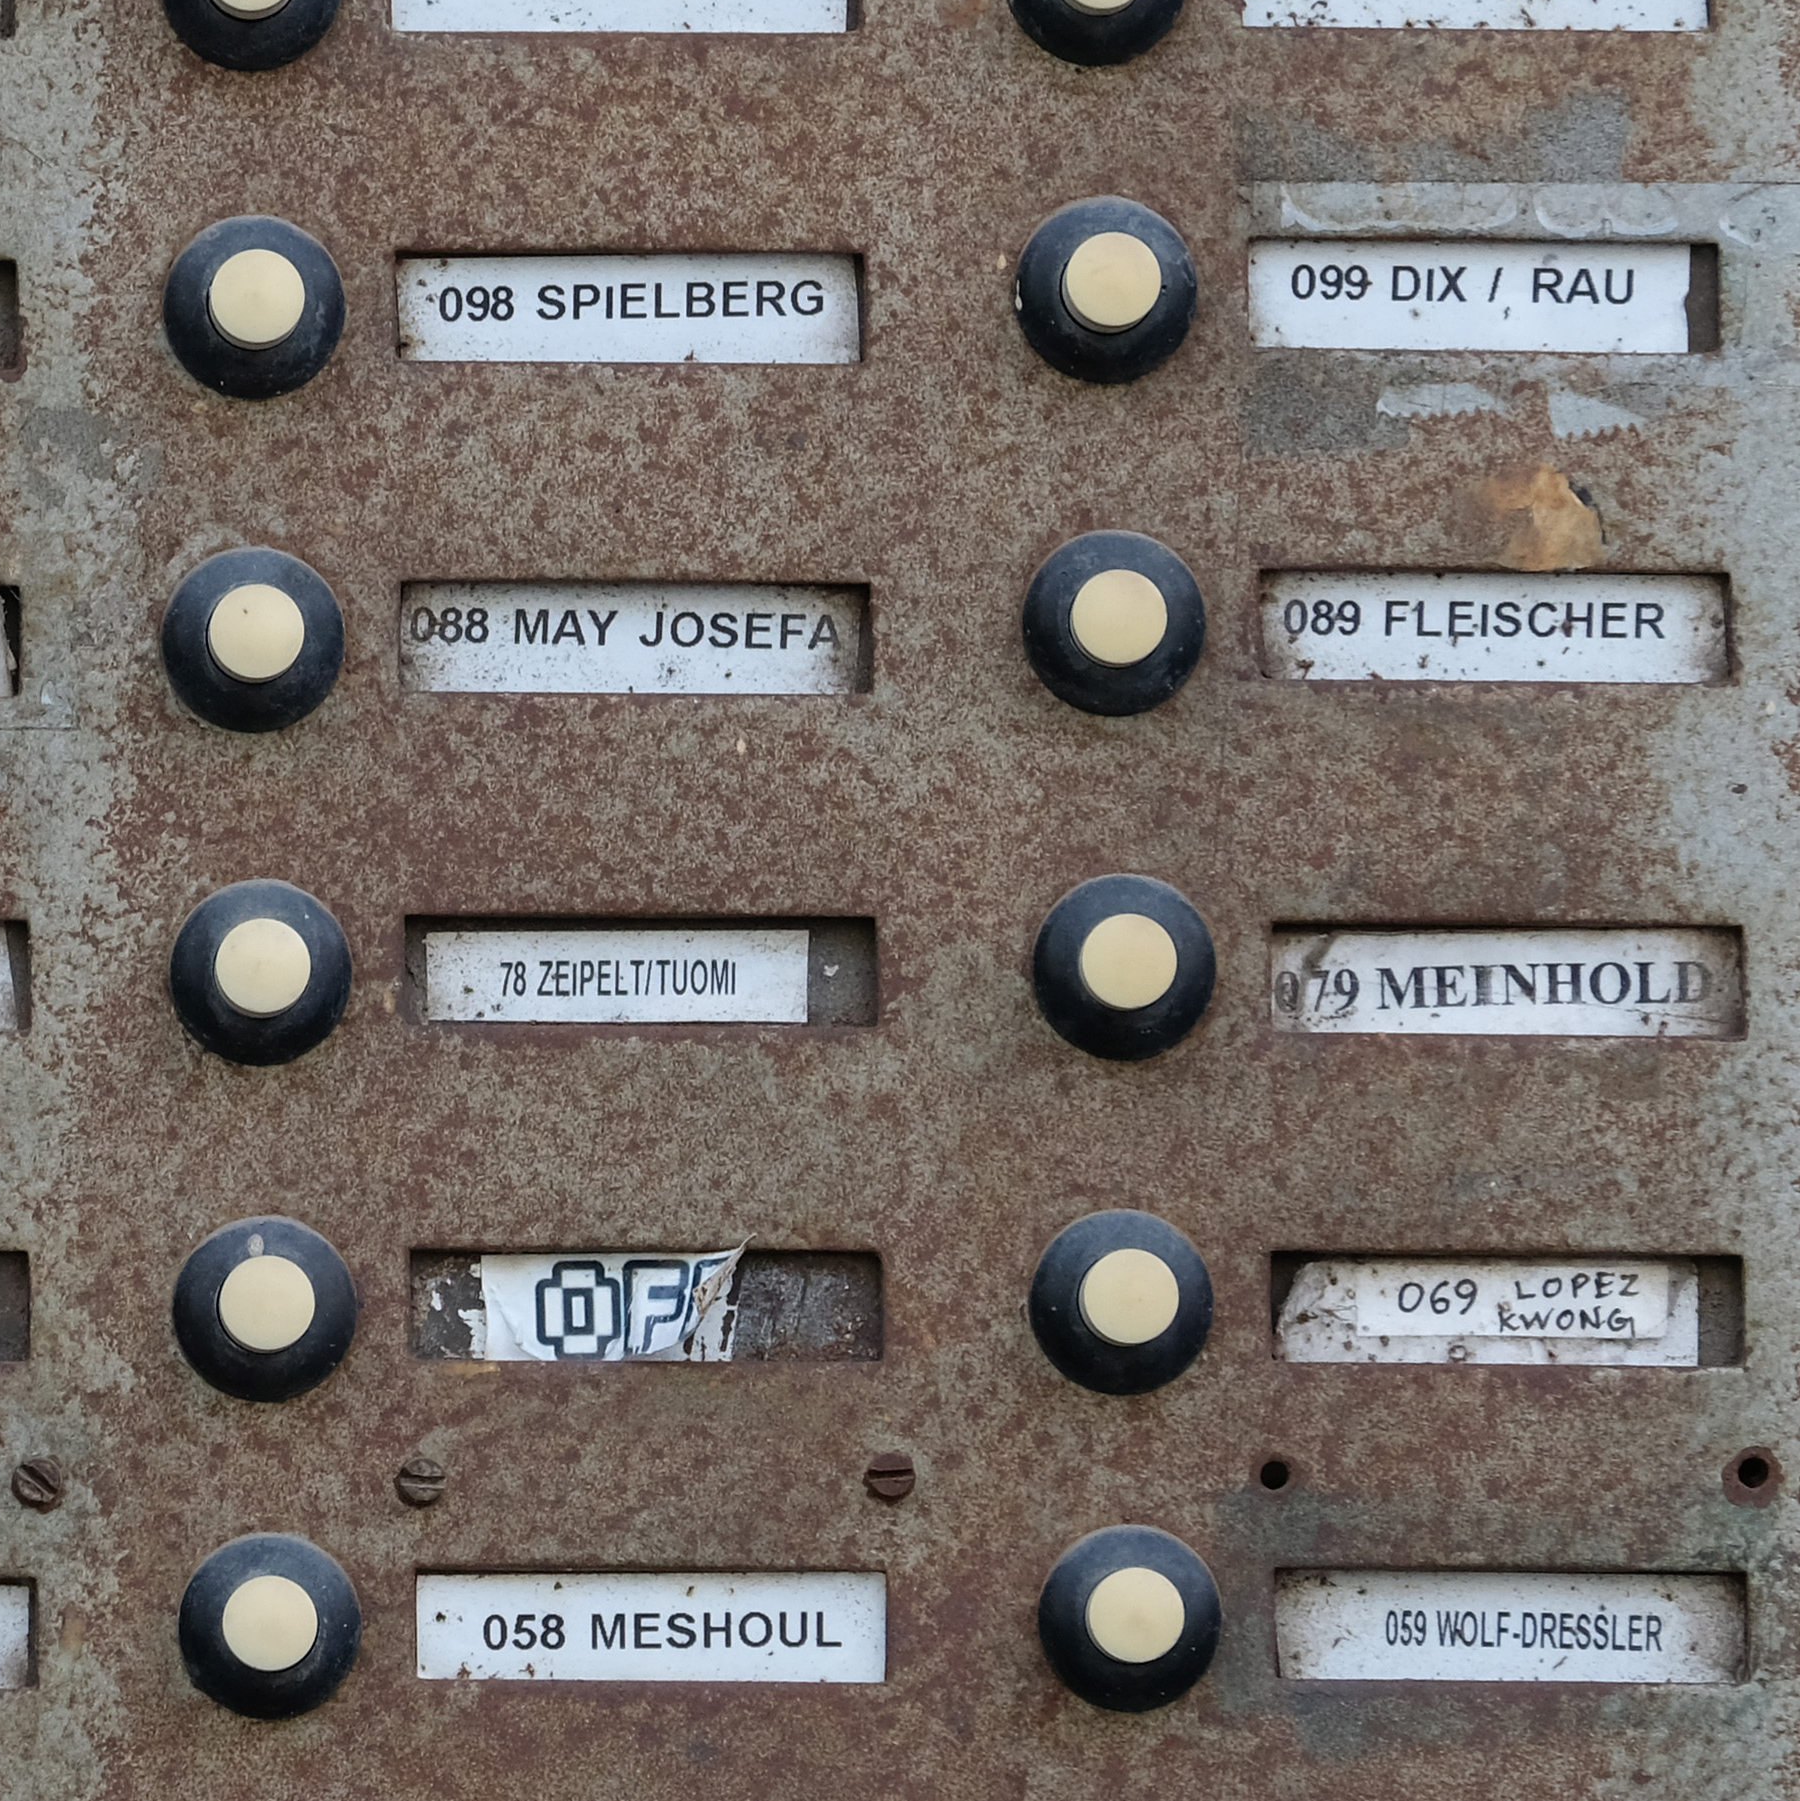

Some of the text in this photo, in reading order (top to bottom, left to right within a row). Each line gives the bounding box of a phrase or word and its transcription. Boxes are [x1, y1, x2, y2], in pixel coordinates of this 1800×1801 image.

[438, 279, 825, 322] 098 SPIELBERG
[1290, 264, 1635, 305] 099 DIX / RAU
[409, 606, 841, 650] 088 MAY JOSEFA
[1284, 599, 1666, 640] 089 FLEISCHER
[500, 959, 736, 997] 78 ZEIPELT/TUOMI
[1375, 960, 1712, 1010] MEINHOLD
[1398, 1272, 1639, 1315] 069 LOPEZ
[1498, 1309, 1636, 1336] KWONG
[483, 1611, 842, 1650] 058 MESHOUL
[1386, 1609, 1662, 1652] 059 WOLF-DRESSLER
